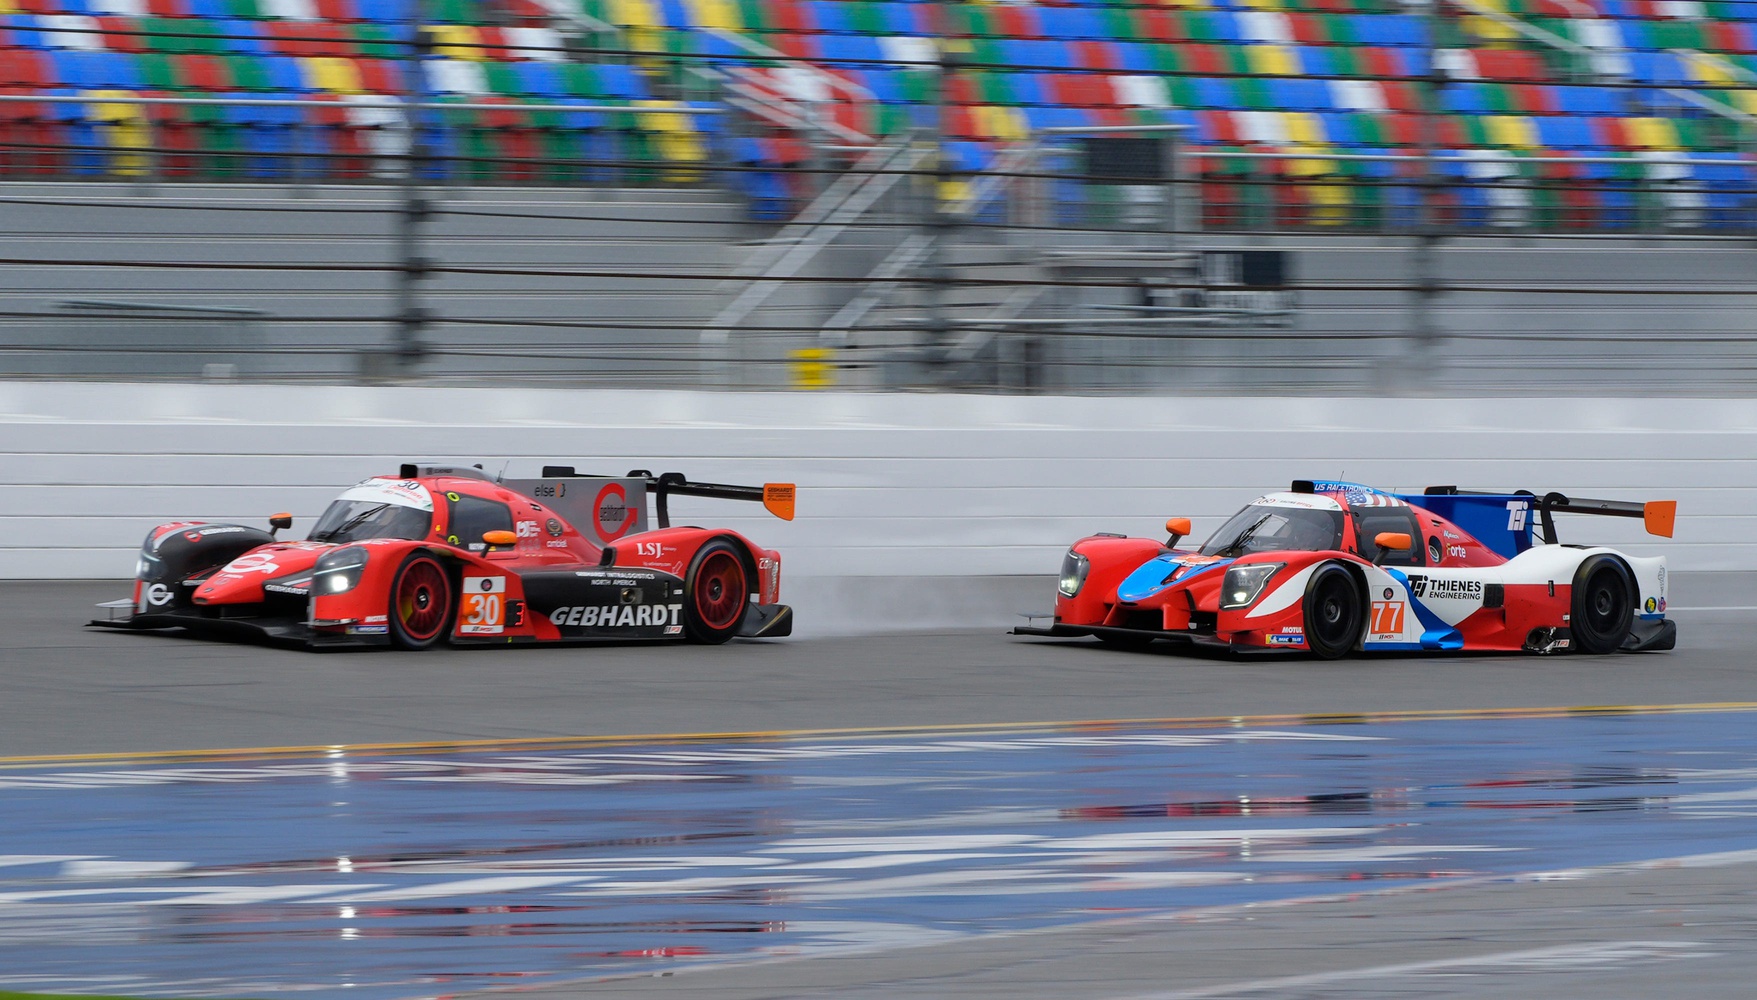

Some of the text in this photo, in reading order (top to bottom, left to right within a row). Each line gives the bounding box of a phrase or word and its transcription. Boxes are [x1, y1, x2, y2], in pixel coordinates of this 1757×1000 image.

[397, 480, 420, 490] 30
[1326, 484, 1374, 494] RACETRONICS
[1446, 542, 1466, 558] Forte
[606, 572, 655, 580] INTRALOGISTICS
[1429, 579, 1482, 592] THIENES
[1429, 591, 1481, 600] ENGINEERING
[467, 594, 500, 625] 30
[549, 603, 683, 627] GEBHARDT
[1373, 602, 1402, 632] 77
[1281, 626, 1303, 634] MOTUL
